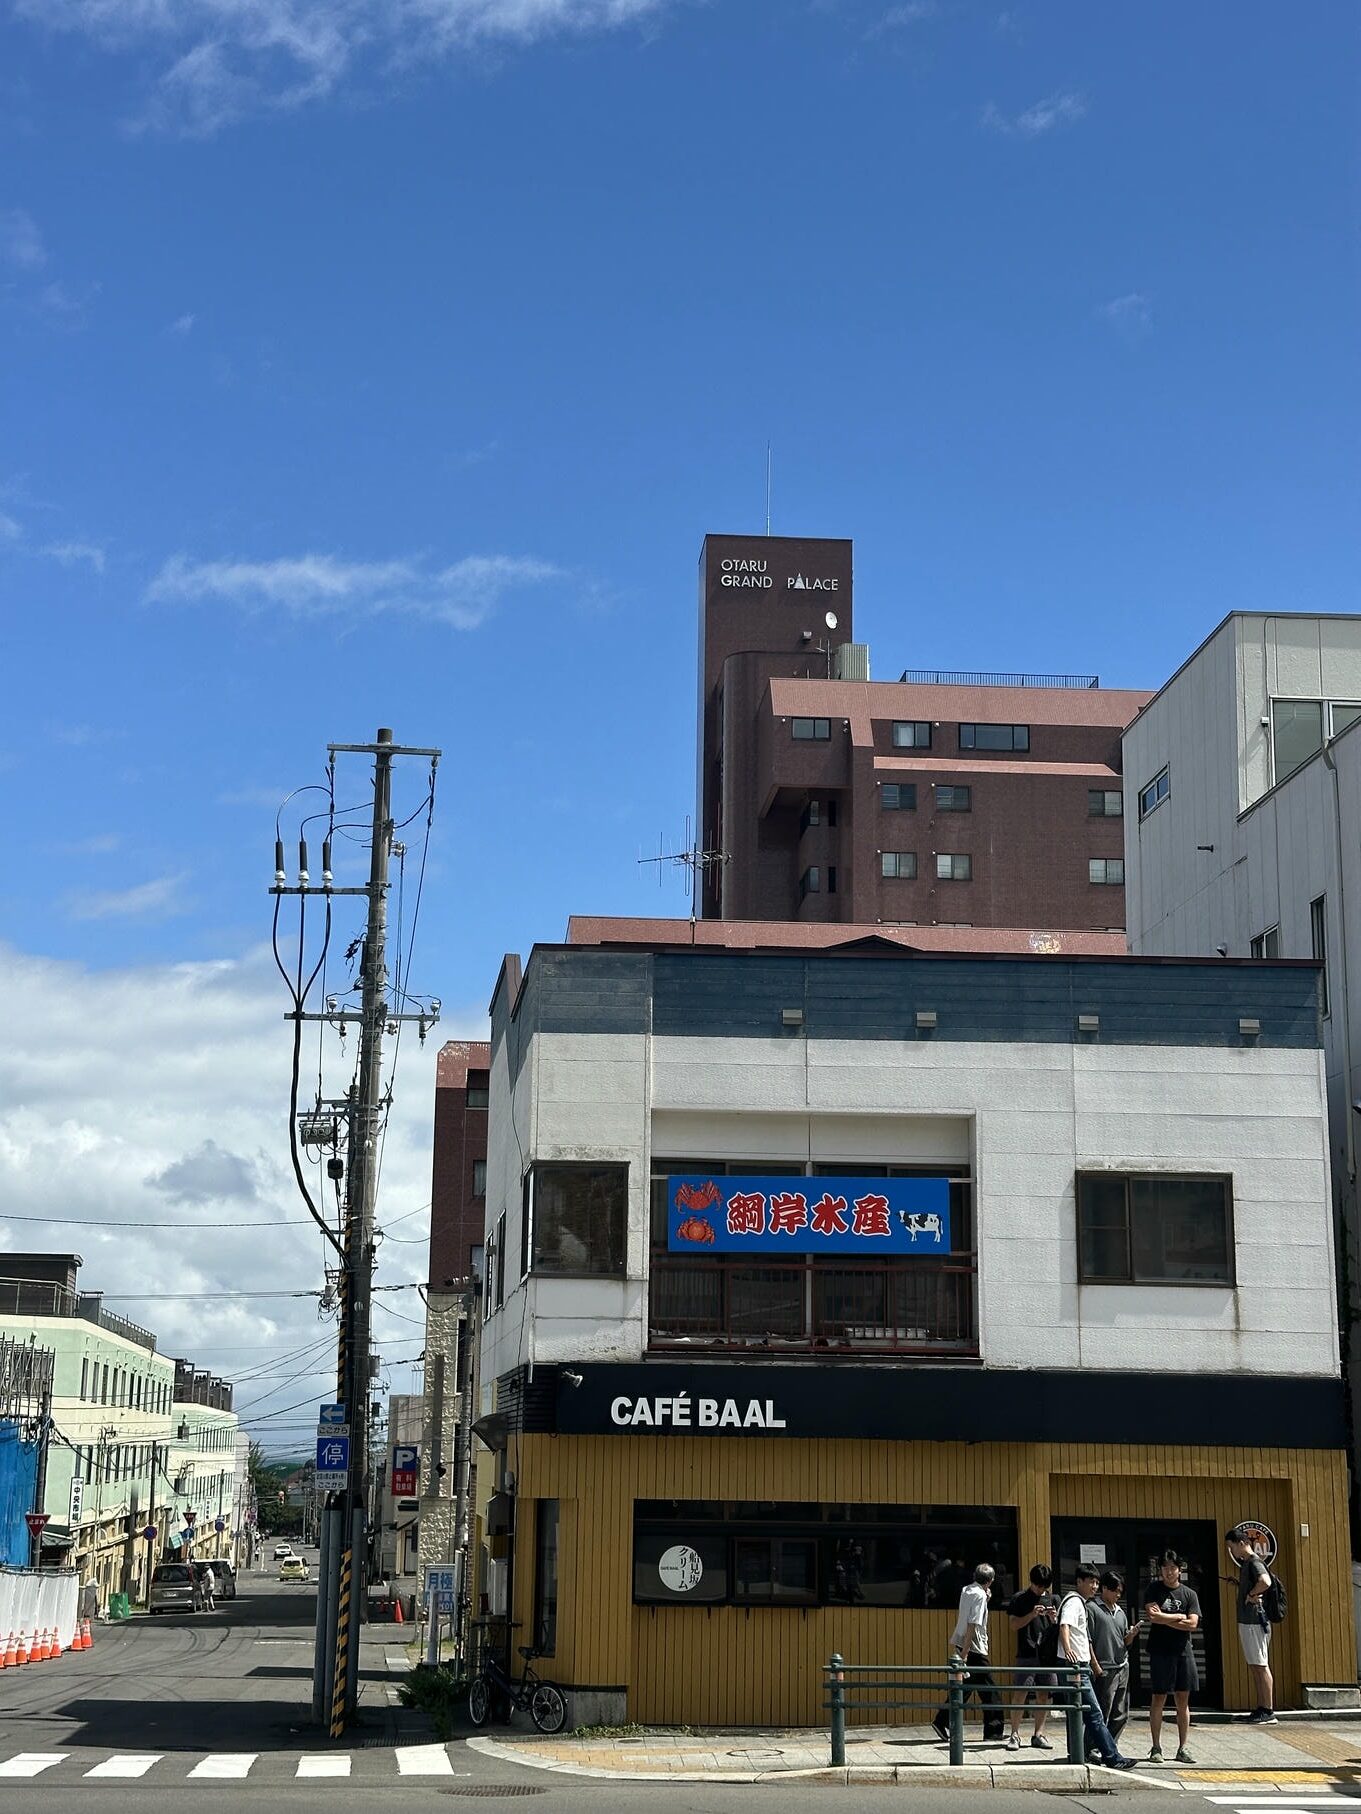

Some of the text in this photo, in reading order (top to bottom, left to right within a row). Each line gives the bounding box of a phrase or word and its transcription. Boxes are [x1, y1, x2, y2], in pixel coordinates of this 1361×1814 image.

[721, 559, 767, 573] OTARU
[721, 573, 838, 590] GRAND PALACE
[610, 1390, 787, 1428] CAFÉ BAAL
[319, 1426, 348, 1434] ここから
[321, 1443, 344, 1465] 停
[396, 1450, 415, 1469] P
[317, 1481, 344, 1489] ここから
[679, 1547, 688, 1590] クリーム
